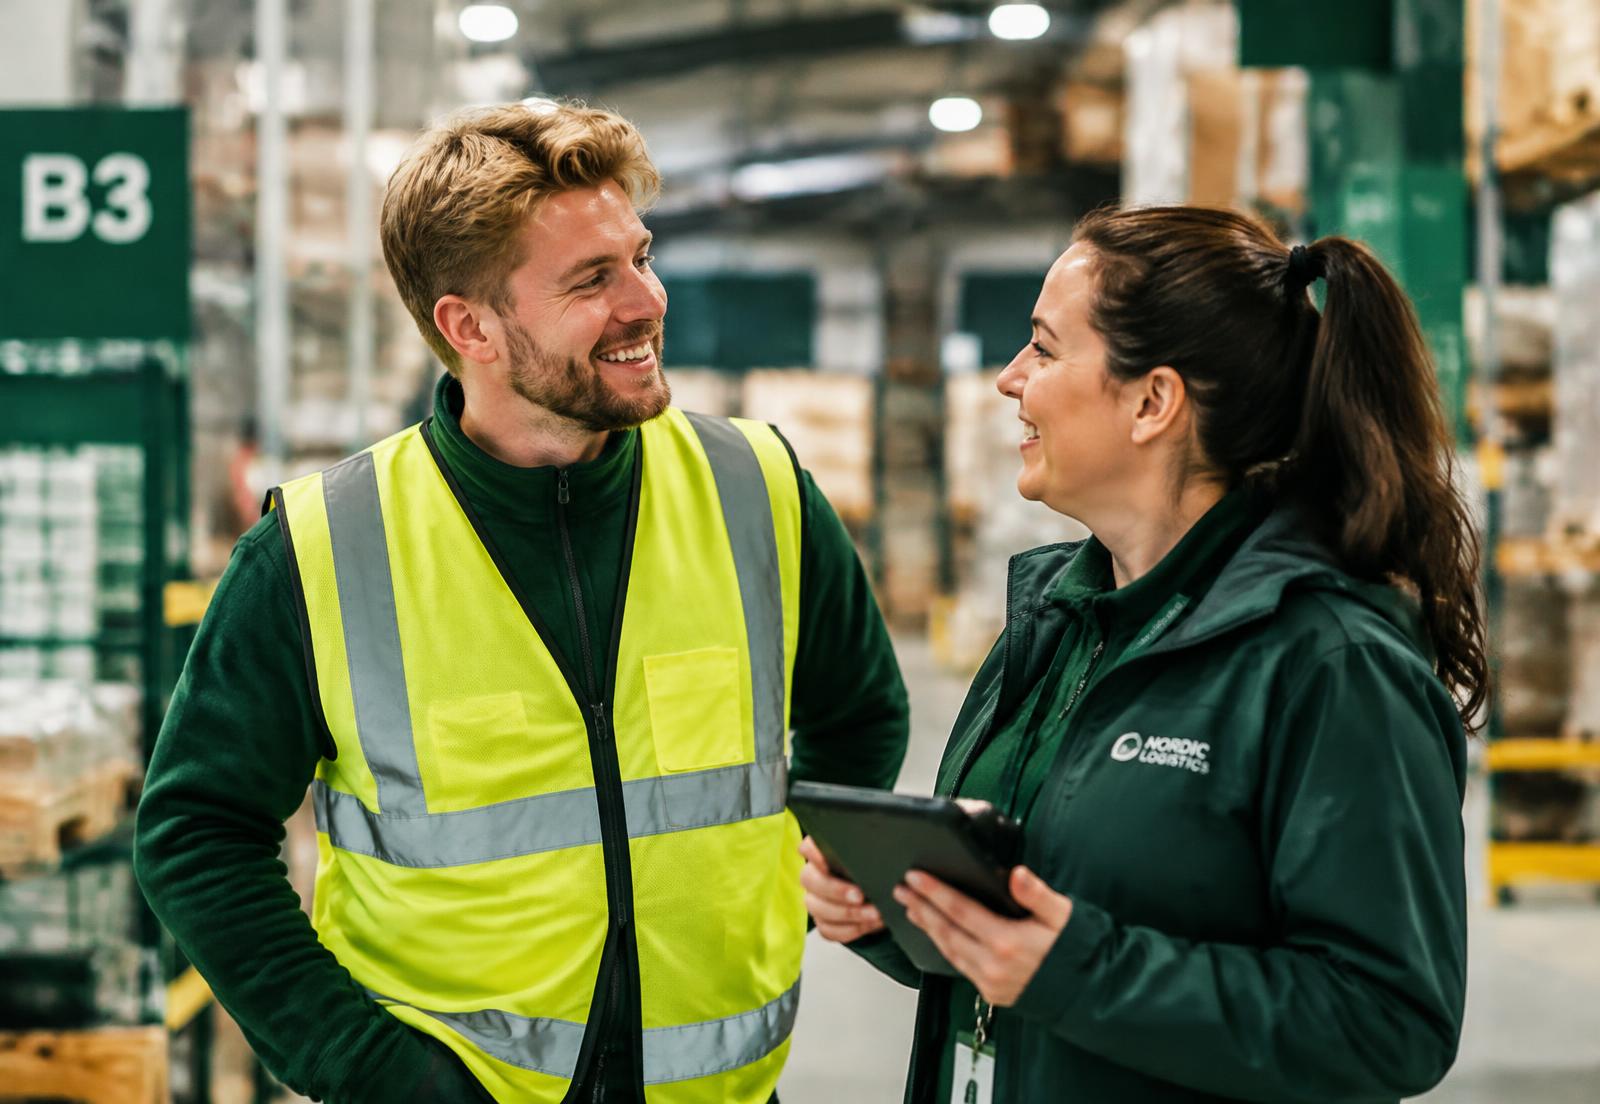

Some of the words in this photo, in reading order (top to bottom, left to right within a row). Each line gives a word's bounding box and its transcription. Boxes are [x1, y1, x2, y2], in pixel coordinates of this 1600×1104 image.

[22, 152, 152, 244] B3
[1144, 736, 1210, 760] NORDIC
[1139, 749, 1210, 774] LOGISTICS
